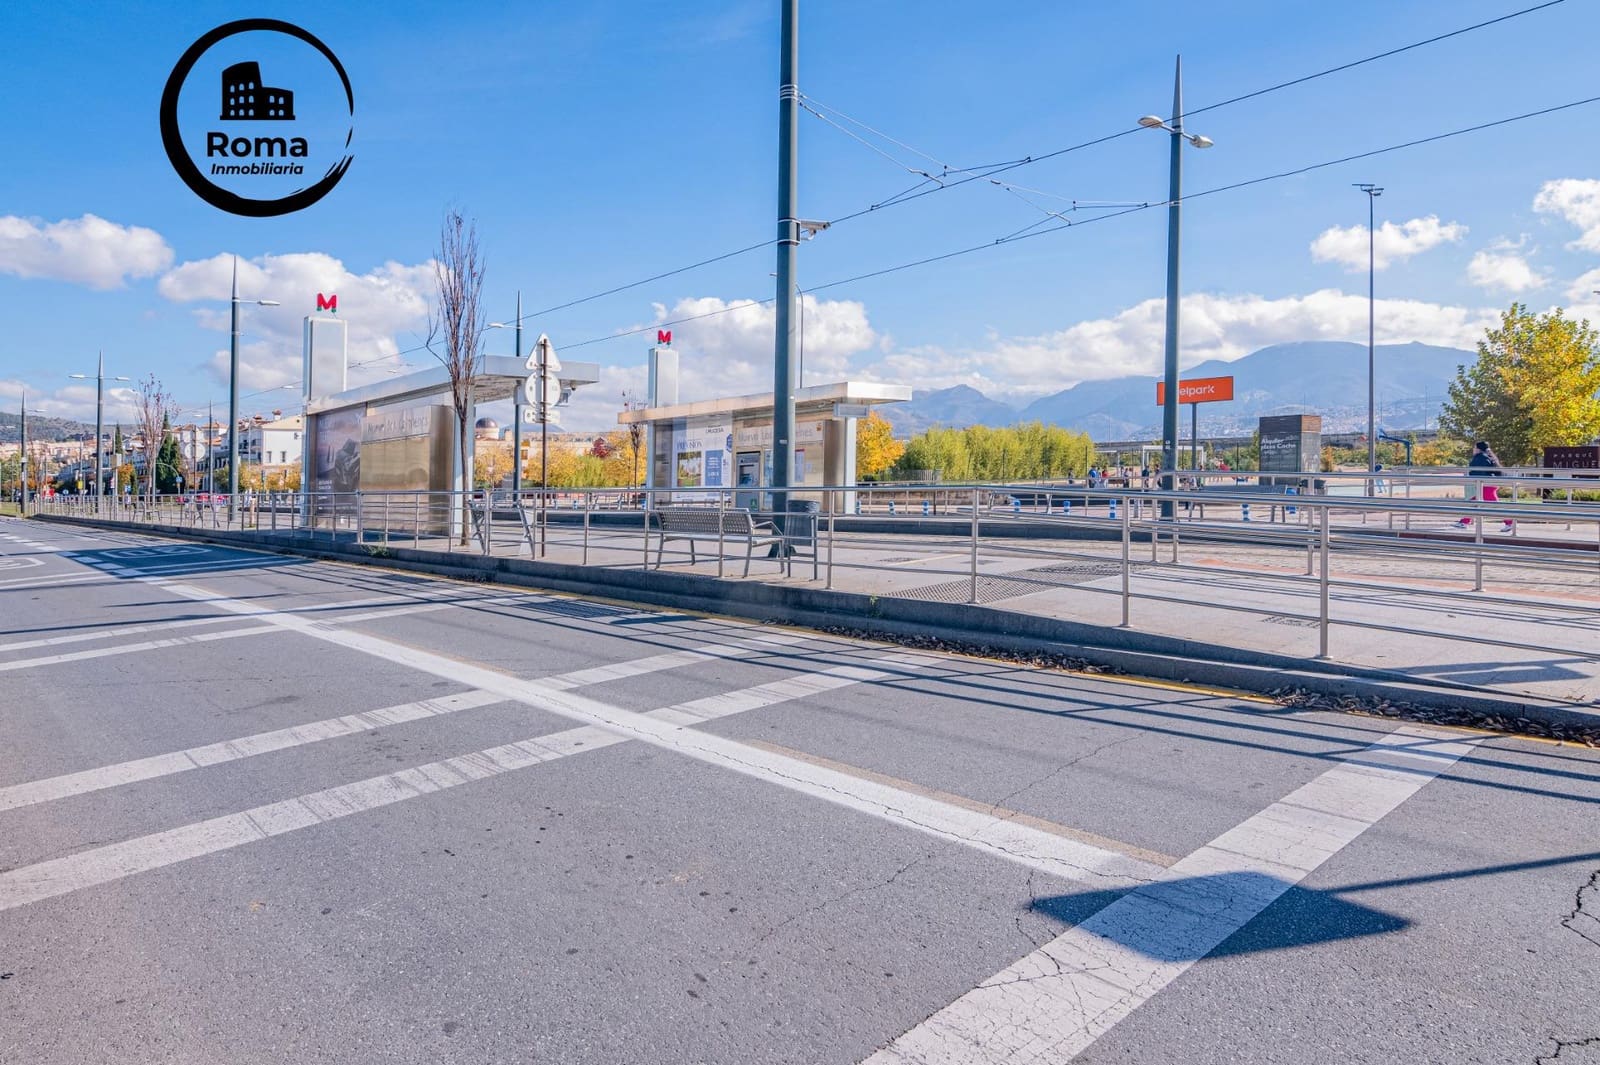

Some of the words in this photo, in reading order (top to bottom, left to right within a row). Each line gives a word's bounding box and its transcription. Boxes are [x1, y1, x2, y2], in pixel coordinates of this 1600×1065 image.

[316, 293, 337, 313] M
[657, 330, 672, 345] M
[1178, 385, 1215, 398] elpark
[1552, 460, 1597, 469] MIGUE
